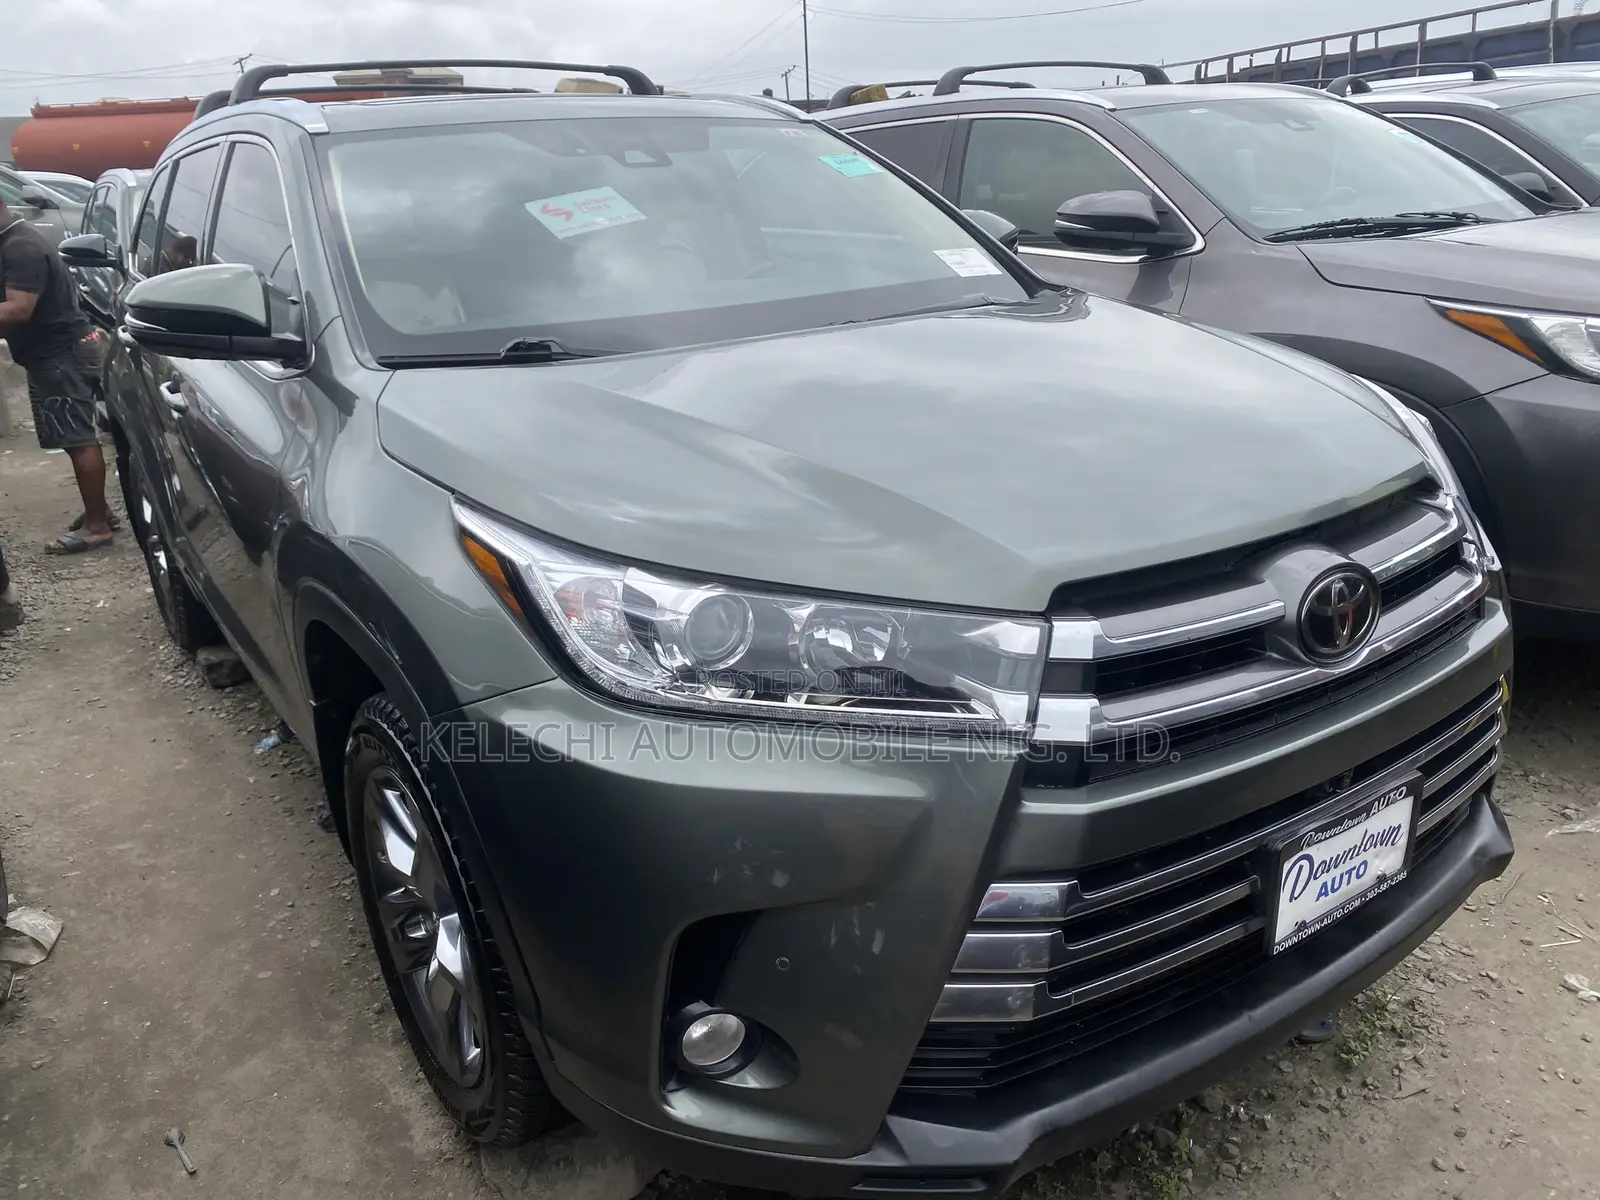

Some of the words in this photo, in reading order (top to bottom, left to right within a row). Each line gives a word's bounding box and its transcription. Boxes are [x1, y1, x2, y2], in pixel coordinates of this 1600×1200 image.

[1301, 813, 1367, 849] Downtown
[1369, 786, 1407, 817] AUTO
[1282, 822, 1404, 903] Downtown
[1315, 860, 1368, 902] AUTO
